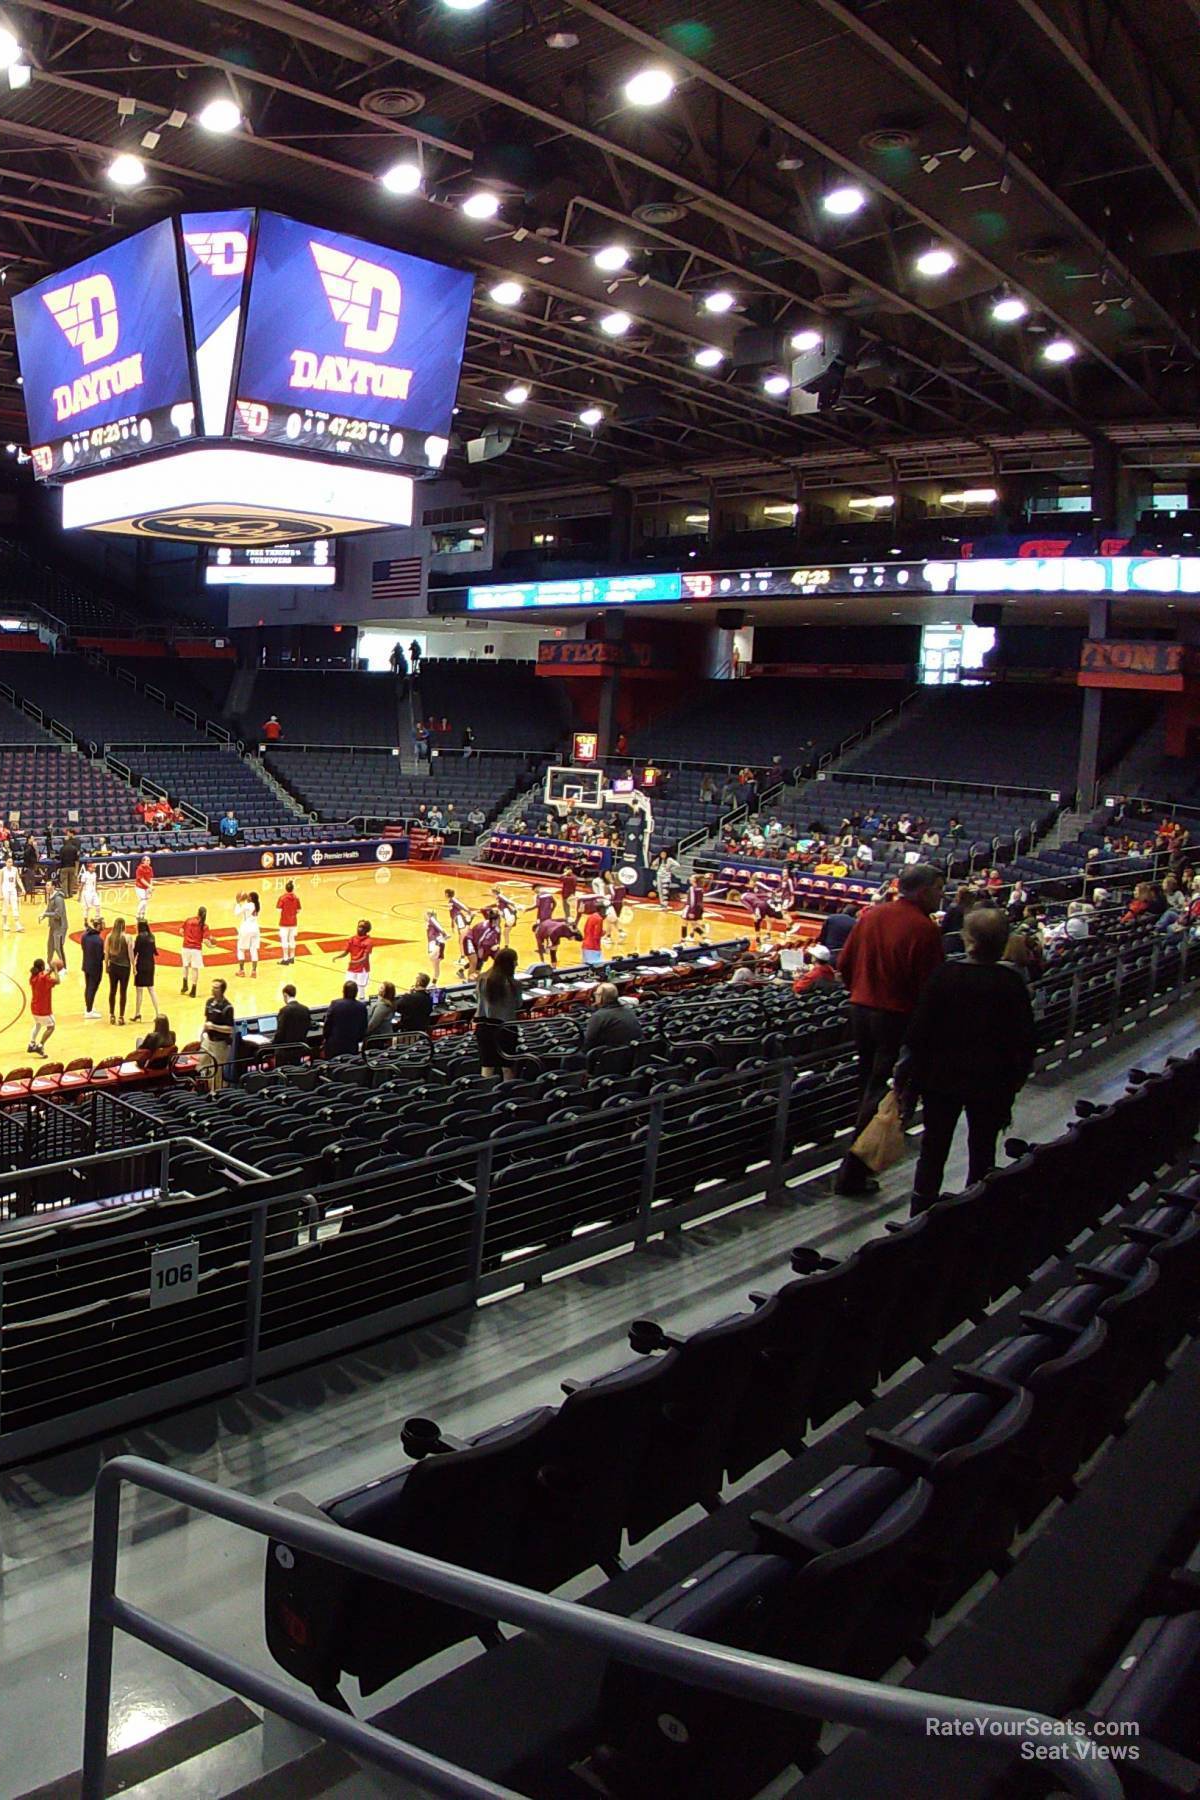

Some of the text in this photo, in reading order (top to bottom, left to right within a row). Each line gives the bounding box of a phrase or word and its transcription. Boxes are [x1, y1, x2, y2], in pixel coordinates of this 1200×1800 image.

[288, 349, 414, 400] DAYTON
[52, 352, 144, 422] DAYTON
[90, 422, 120, 447] 47:23
[328, 416, 367, 440] 47:23
[155, 517, 306, 539] Kroger
[791, 569, 830, 585] 47:23
[579, 743, 594, 758] 30
[276, 851, 303, 866] PNC
[324, 851, 343, 860] Premier
[156, 1263, 193, 1289] 106
